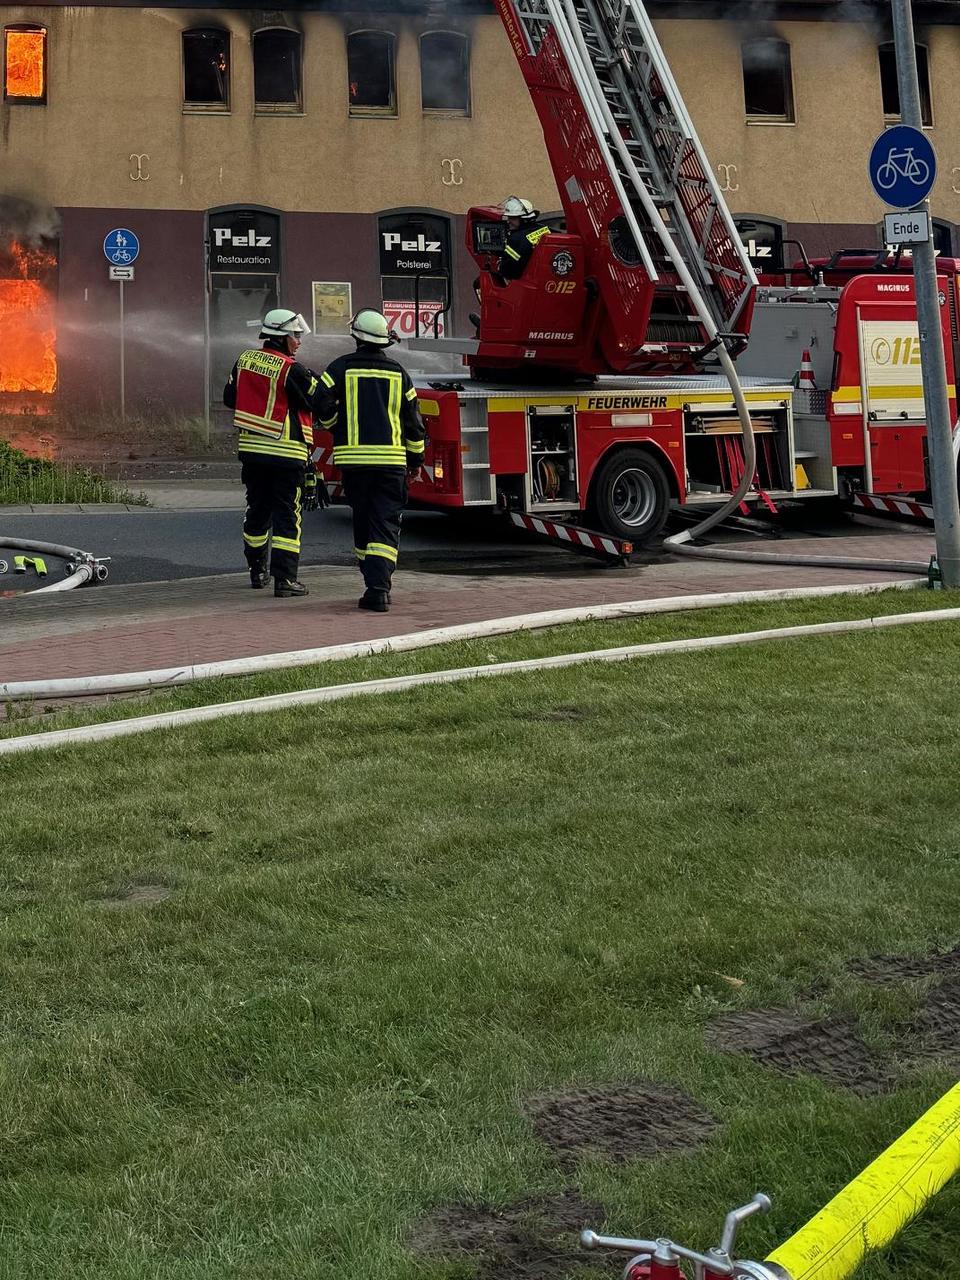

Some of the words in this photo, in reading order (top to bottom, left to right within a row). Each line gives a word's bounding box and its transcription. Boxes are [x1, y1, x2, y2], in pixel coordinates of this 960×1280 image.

[893, 222, 919, 234] Ende
[213, 228, 272, 247] Pelz
[382, 232, 442, 252] Pelz
[217, 255, 271, 264] Restauration
[396, 260, 432, 269] Polsterei
[555, 281, 576, 294] 112
[877, 284, 910, 292] MAGIRUS
[528, 331, 574, 340] MAGIRUS
[588, 396, 667, 409] FEUERWEHR
